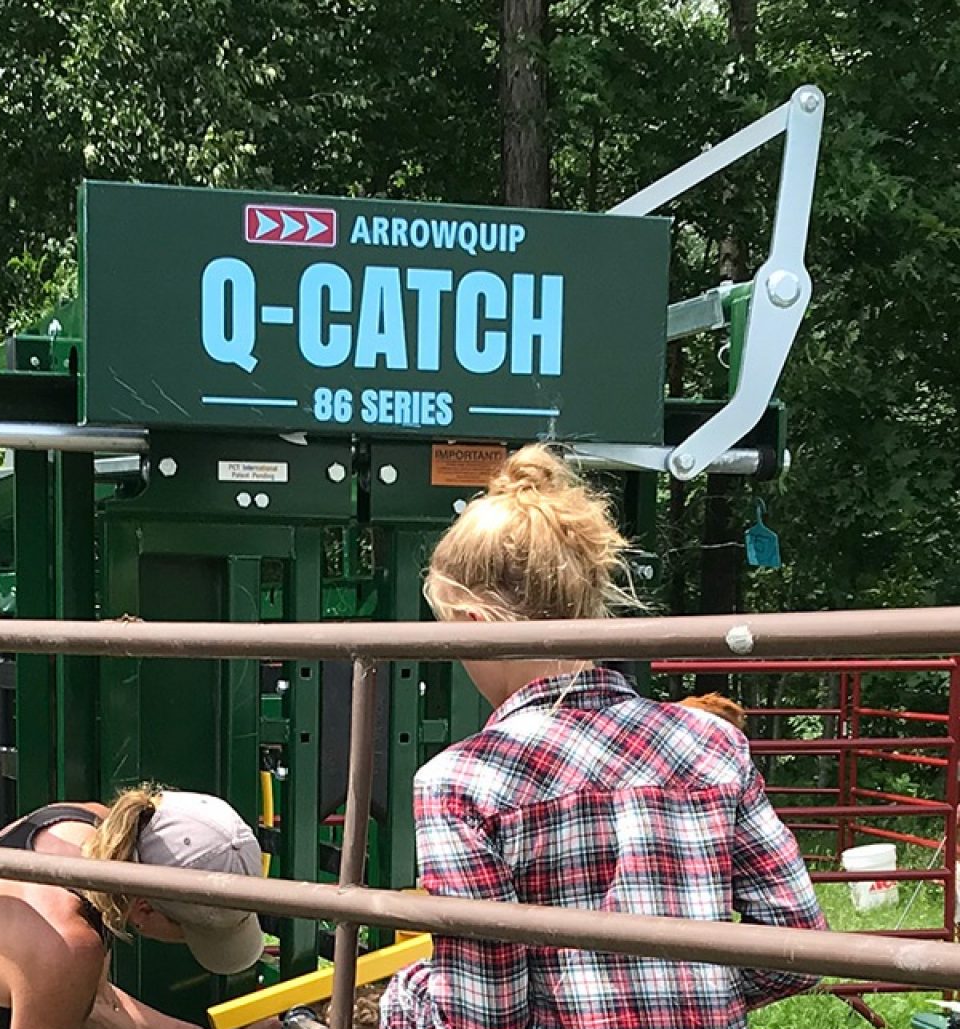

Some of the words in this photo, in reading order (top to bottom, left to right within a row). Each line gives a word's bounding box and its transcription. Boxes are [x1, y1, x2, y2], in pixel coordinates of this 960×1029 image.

[350, 215, 526, 255] ARROWQUIP
[201, 256, 564, 376] Q-CATCH
[313, 387, 353, 423] 86
[361, 389, 453, 426] SERIES
